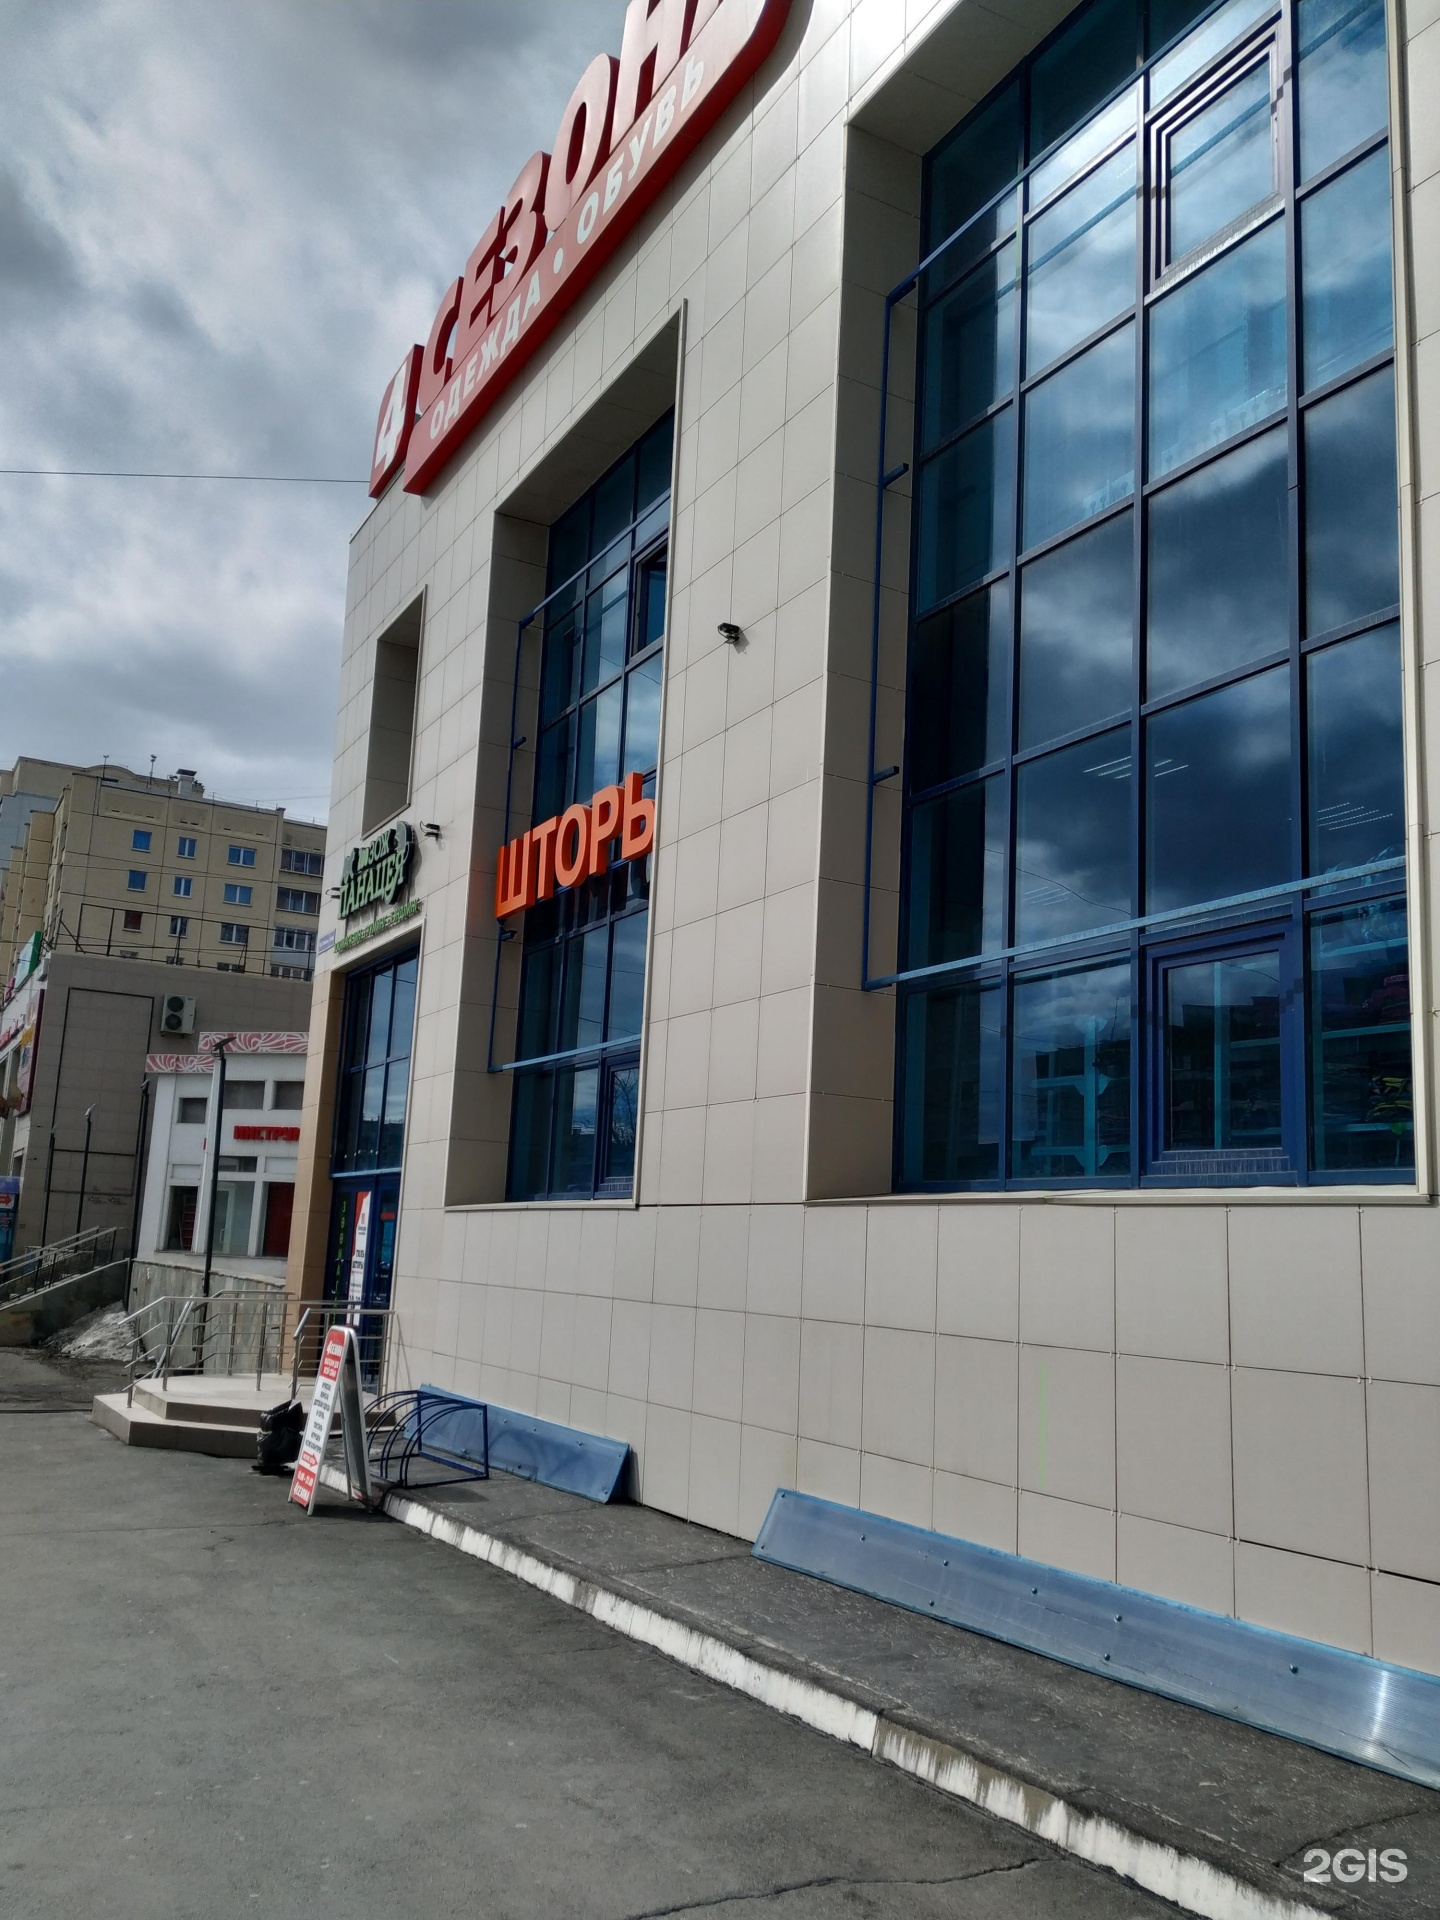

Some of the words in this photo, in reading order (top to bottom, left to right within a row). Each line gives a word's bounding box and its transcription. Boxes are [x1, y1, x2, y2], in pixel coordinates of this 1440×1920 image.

[417, 0, 724, 415] СЕЗОН
[429, 270, 542, 441] ОДЕЖДА
[576, 54, 706, 245] ОБУВЬ
[337, 849, 407, 919] ПАНАЦЕЯ
